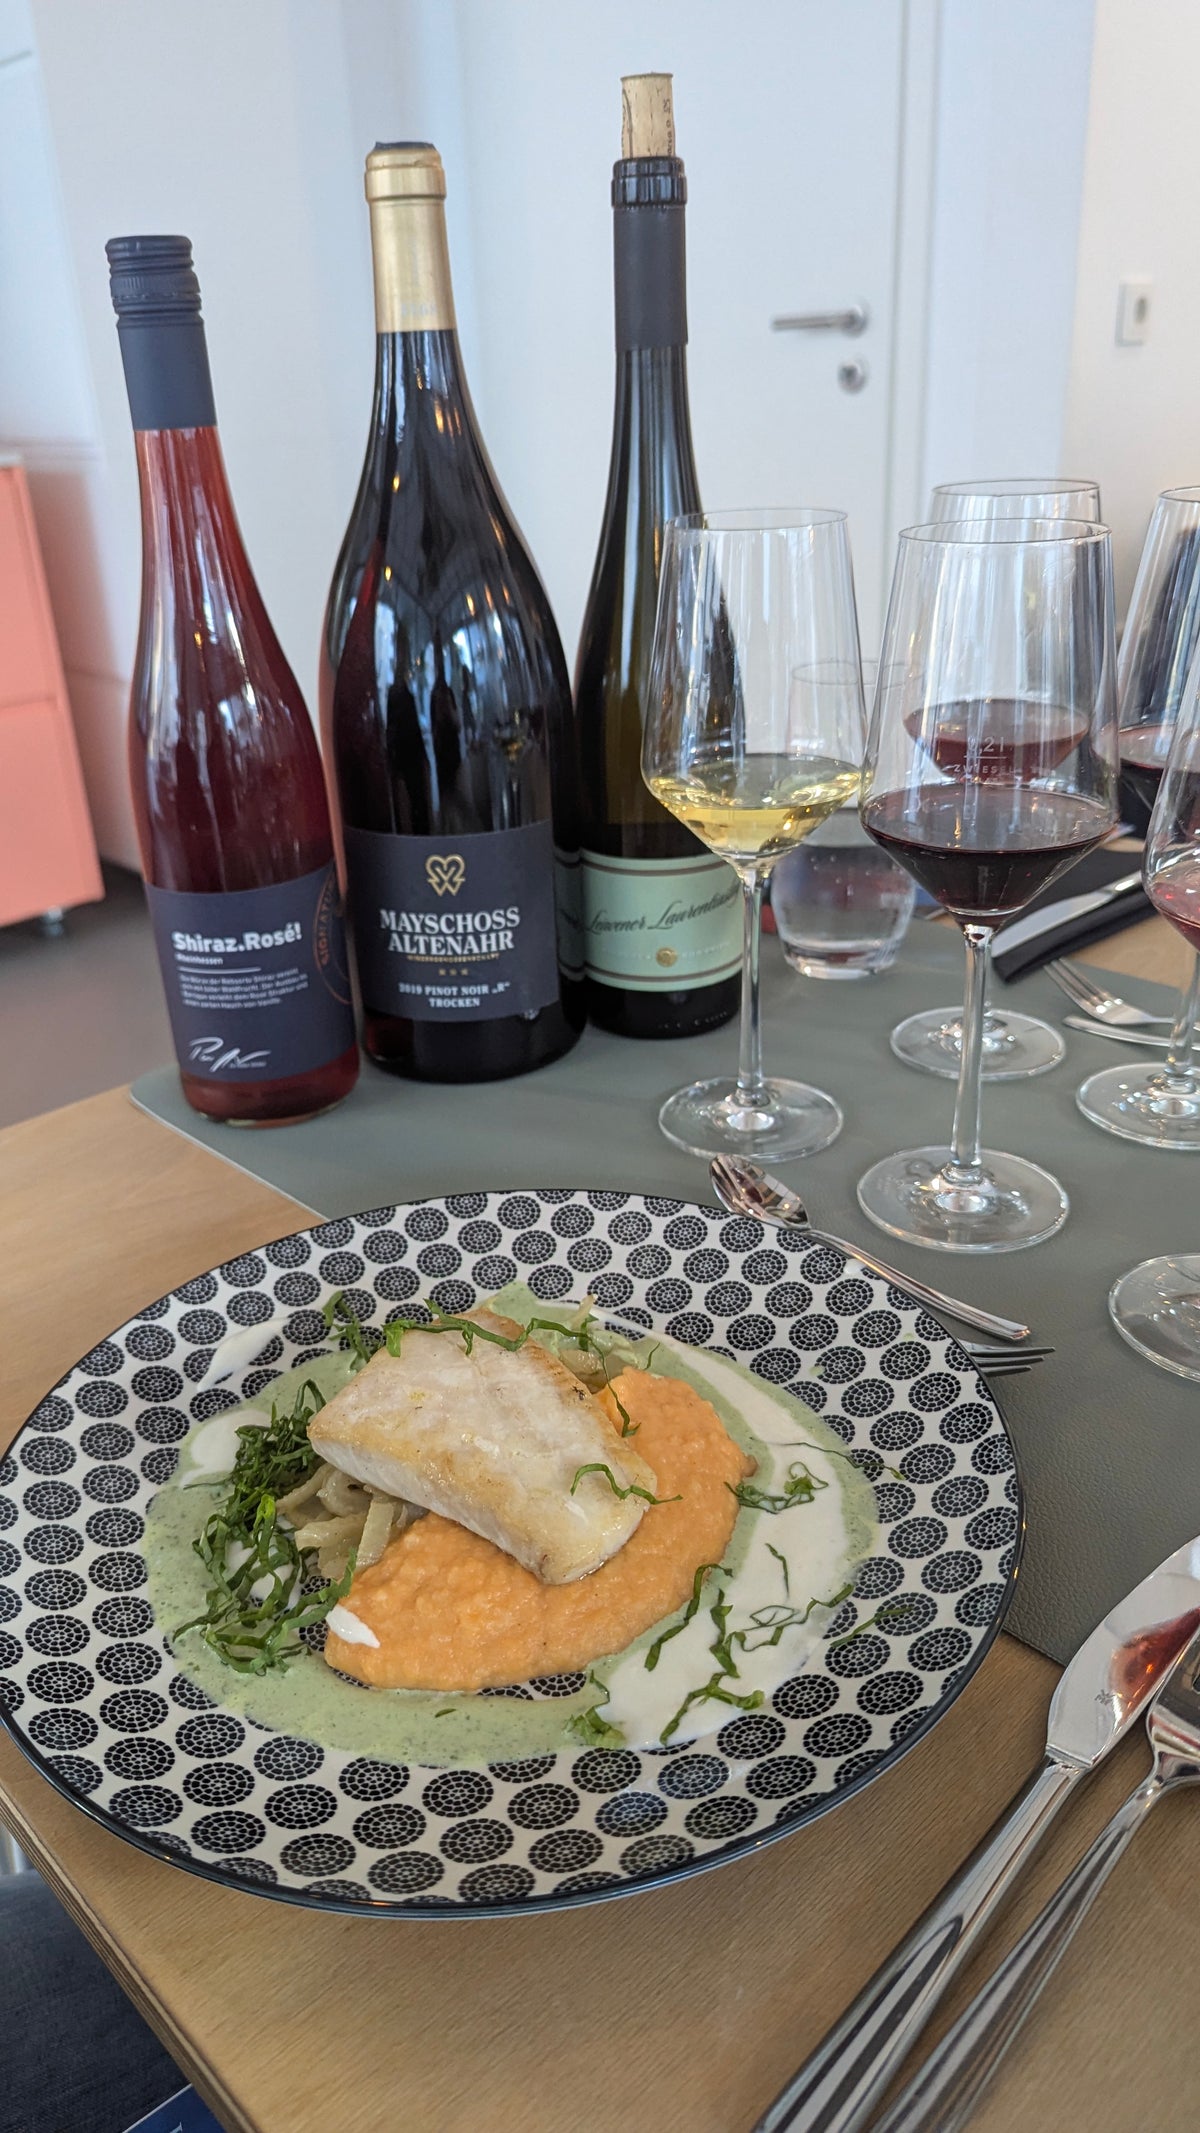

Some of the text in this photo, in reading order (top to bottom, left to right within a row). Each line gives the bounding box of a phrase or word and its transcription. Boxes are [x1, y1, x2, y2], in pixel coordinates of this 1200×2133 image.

[380, 906, 520, 934] MAYSCHOSS
[172, 921, 302, 953] Shiraz.Rosé!
[388, 930, 515, 956] ALTENAHR
[175, 953, 224, 965] Rheinhessen
[398, 982, 423, 995] 2019
[424, 985, 458, 996] PINOT
[461, 984, 489, 995] NOIR
[429, 997, 481, 1008] TROCKEN
